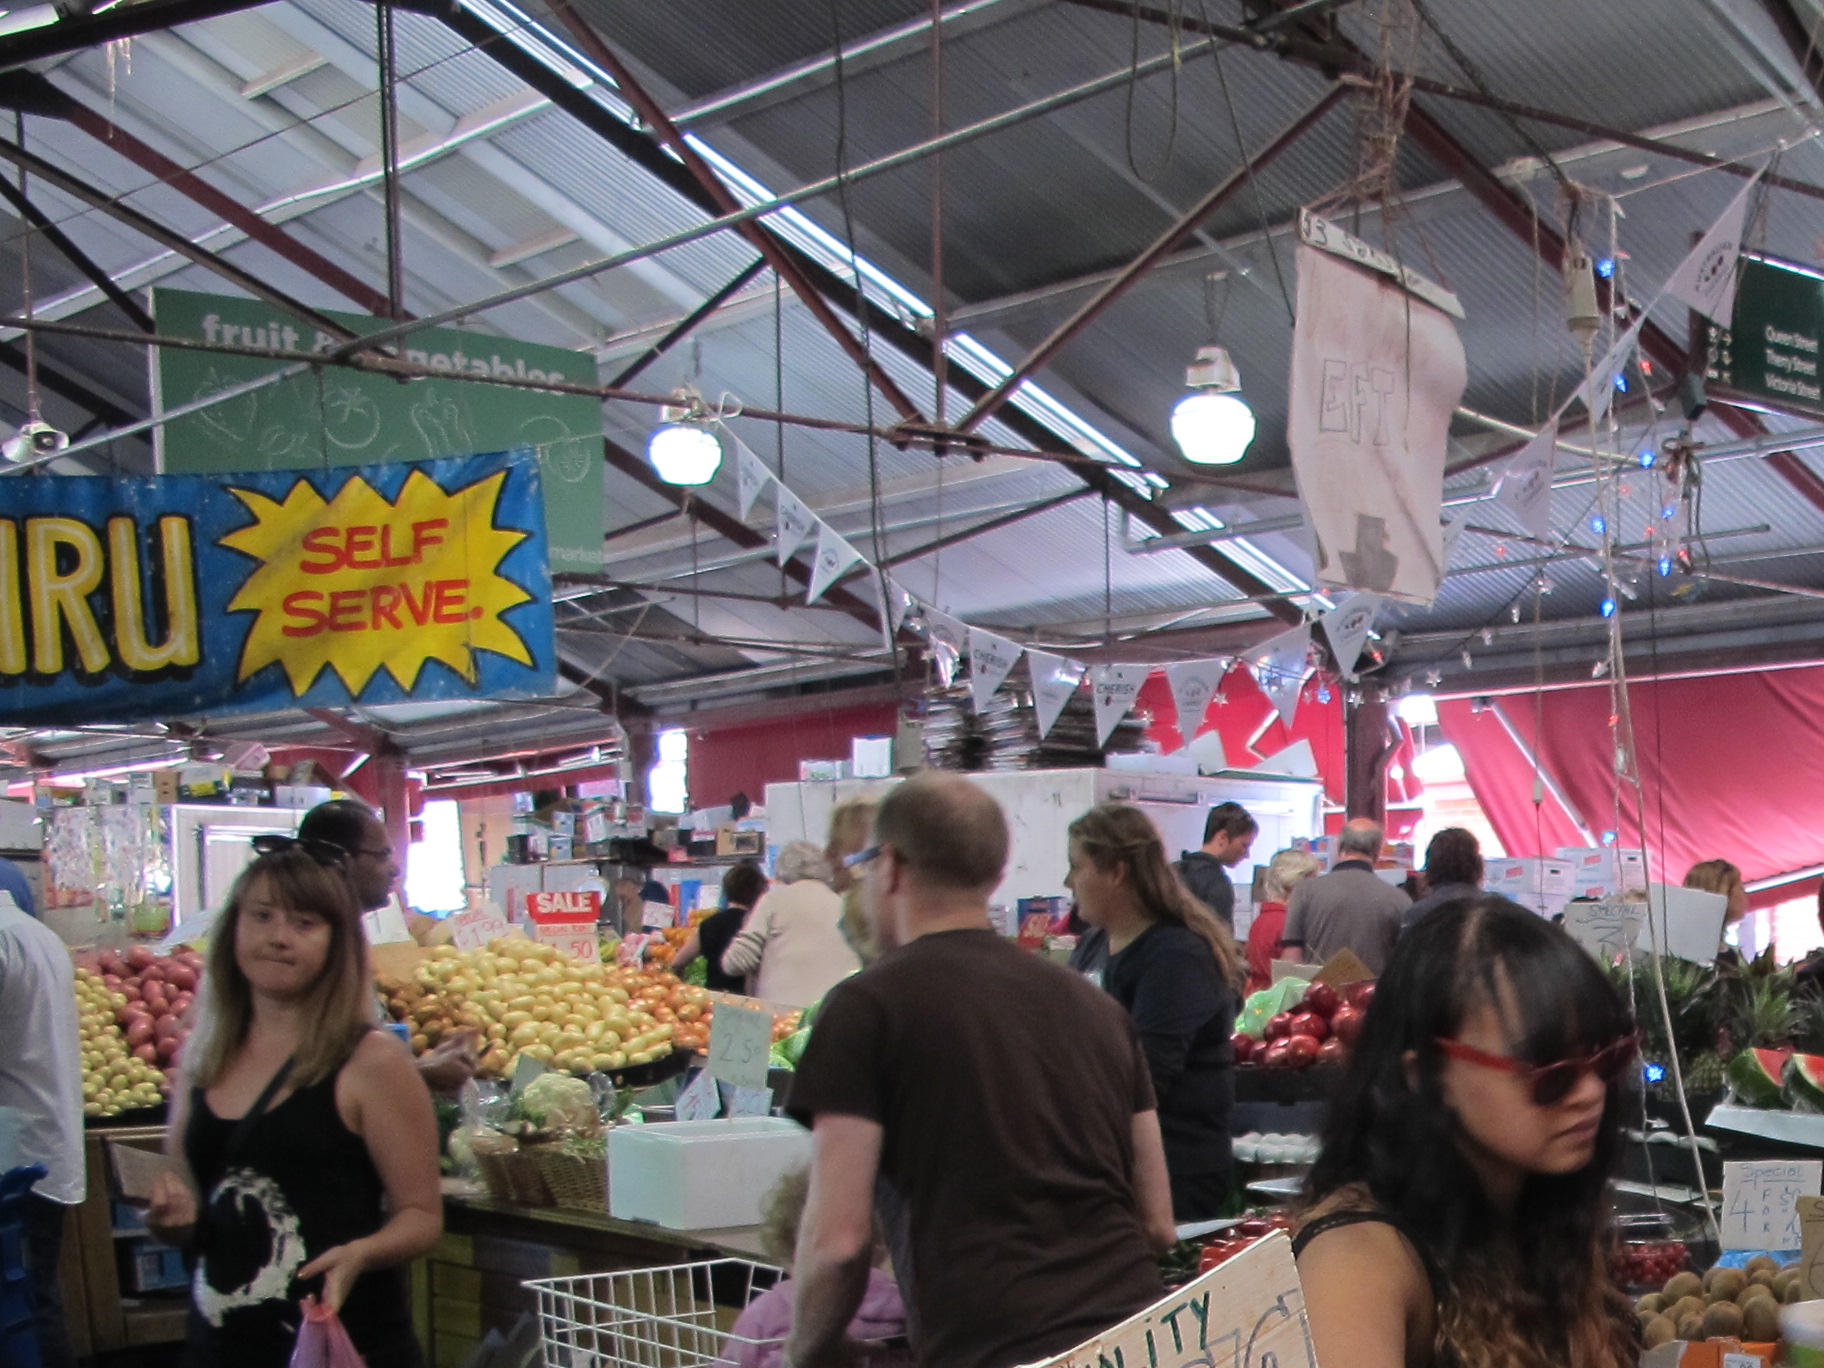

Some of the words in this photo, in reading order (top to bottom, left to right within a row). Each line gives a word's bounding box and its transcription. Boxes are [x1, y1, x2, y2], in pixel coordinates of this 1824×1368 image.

[1319, 358, 1395, 447] EFT
[300, 518, 449, 575] SELF
[282, 578, 485, 638] SERVE.
[536, 891, 593, 913] SALE
